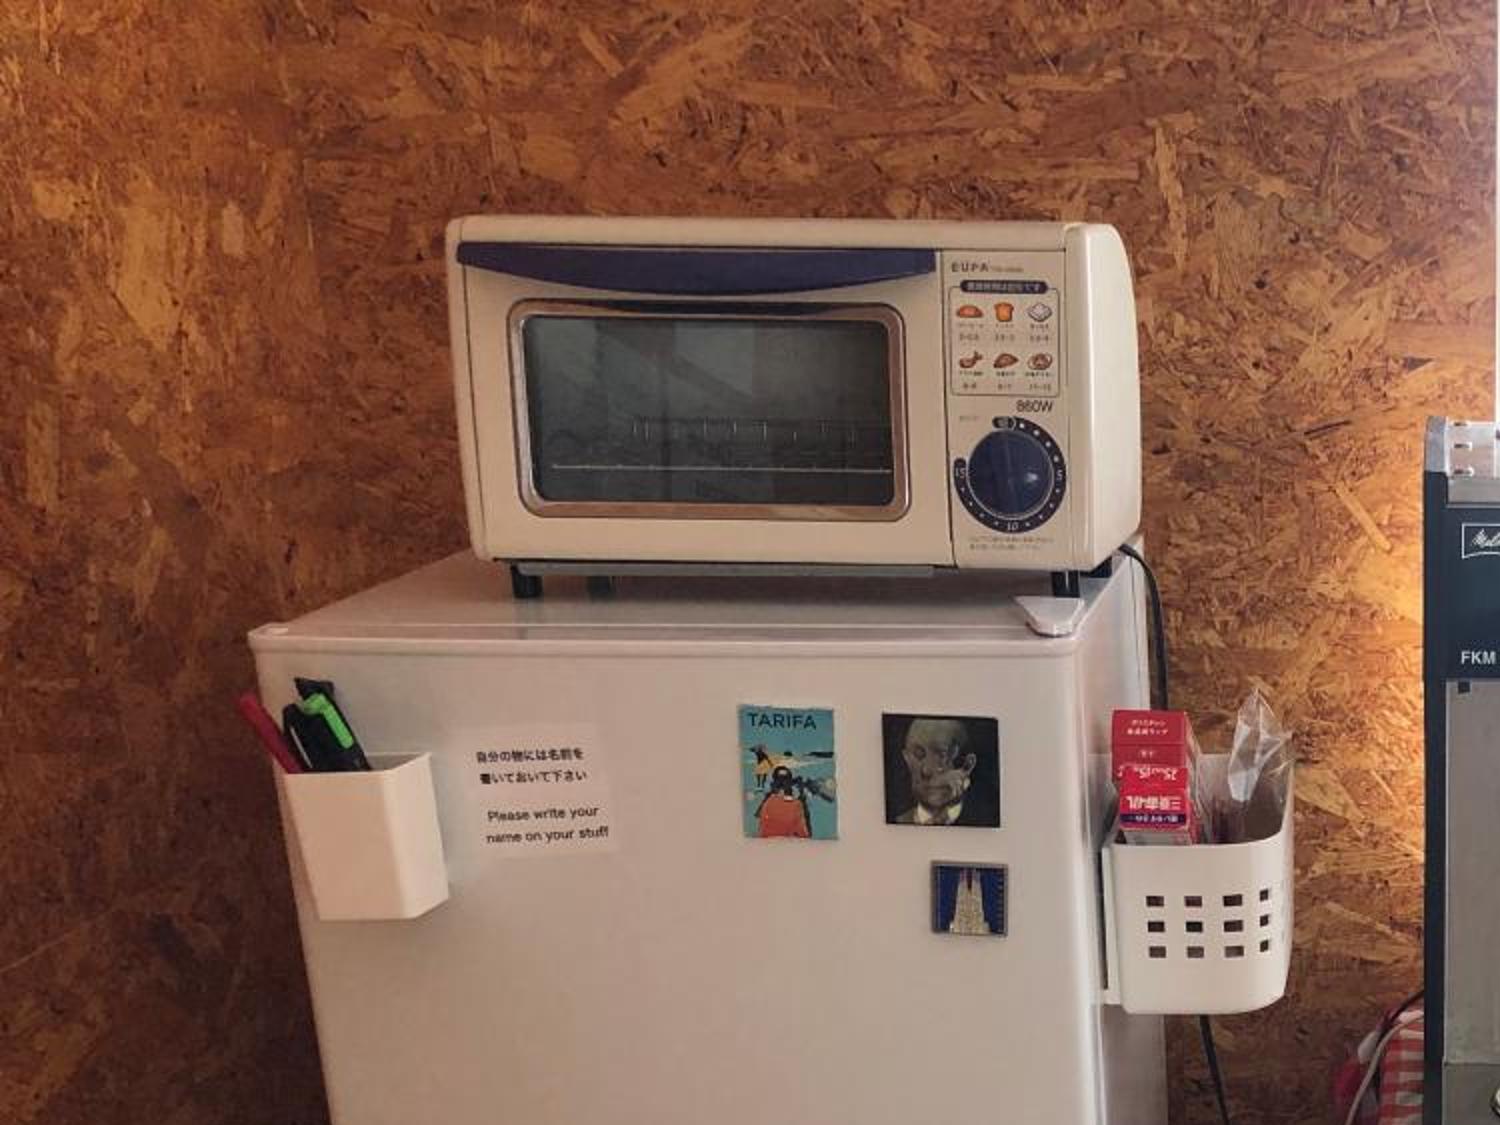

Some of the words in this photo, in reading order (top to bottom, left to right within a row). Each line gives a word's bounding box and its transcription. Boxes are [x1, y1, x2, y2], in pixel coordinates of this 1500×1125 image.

[951, 262, 989, 273] EUPA
[1460, 650, 1496, 665] FKM
[747, 711, 818, 730] TARIFA
[487, 809, 529, 822] Please
[534, 807, 566, 820] write
[570, 806, 599, 820] your
[486, 833, 523, 844] name
[525, 832, 542, 842] on
[545, 830, 575, 844] your
[579, 826, 609, 839] stuff
